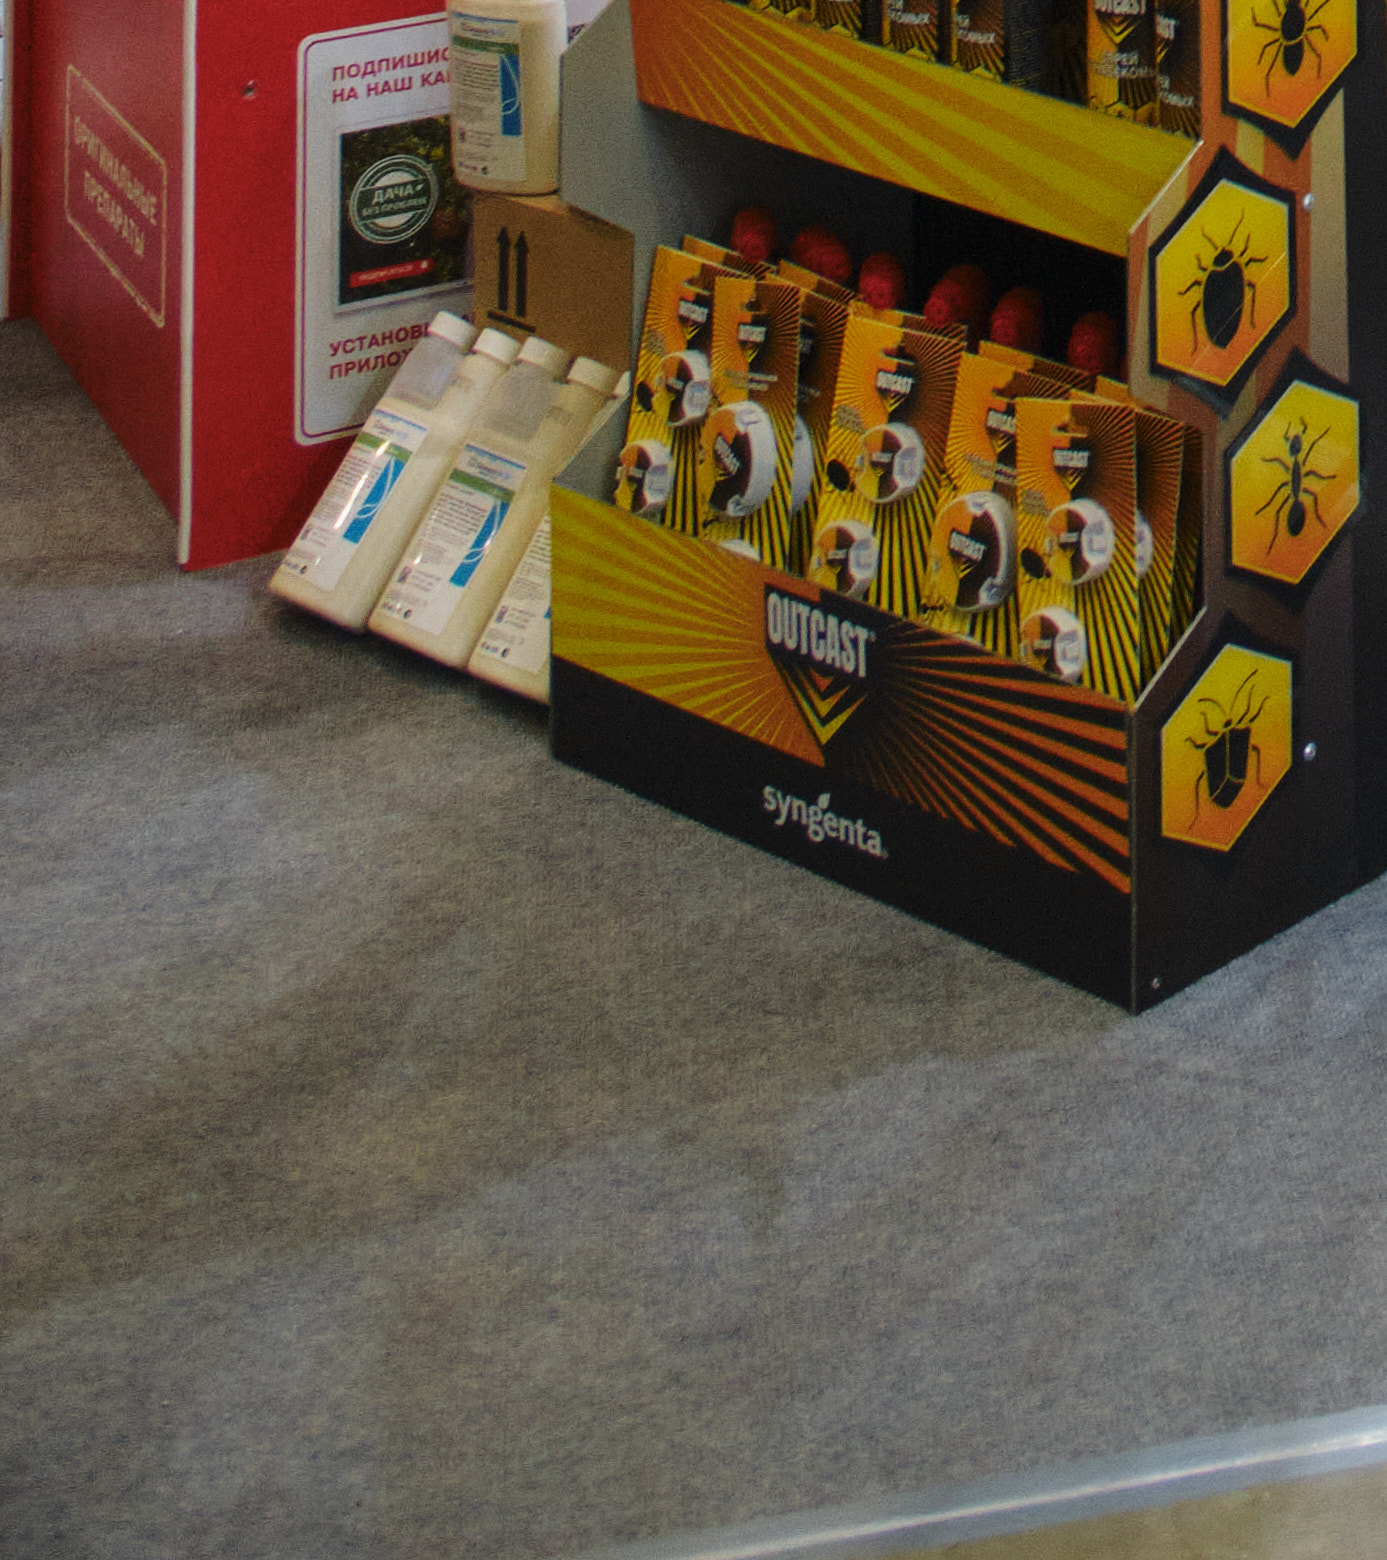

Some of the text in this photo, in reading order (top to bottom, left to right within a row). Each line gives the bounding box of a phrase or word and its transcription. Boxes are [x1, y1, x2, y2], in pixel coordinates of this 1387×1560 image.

[332, 46, 449, 83] ПОДПИШИС
[332, 83, 359, 104] НА
[366, 75, 413, 99] НАШ
[372, 181, 414, 205] ДАЧА
[329, 321, 430, 357] УСТАНОВ
[762, 785, 884, 858] syngenta
